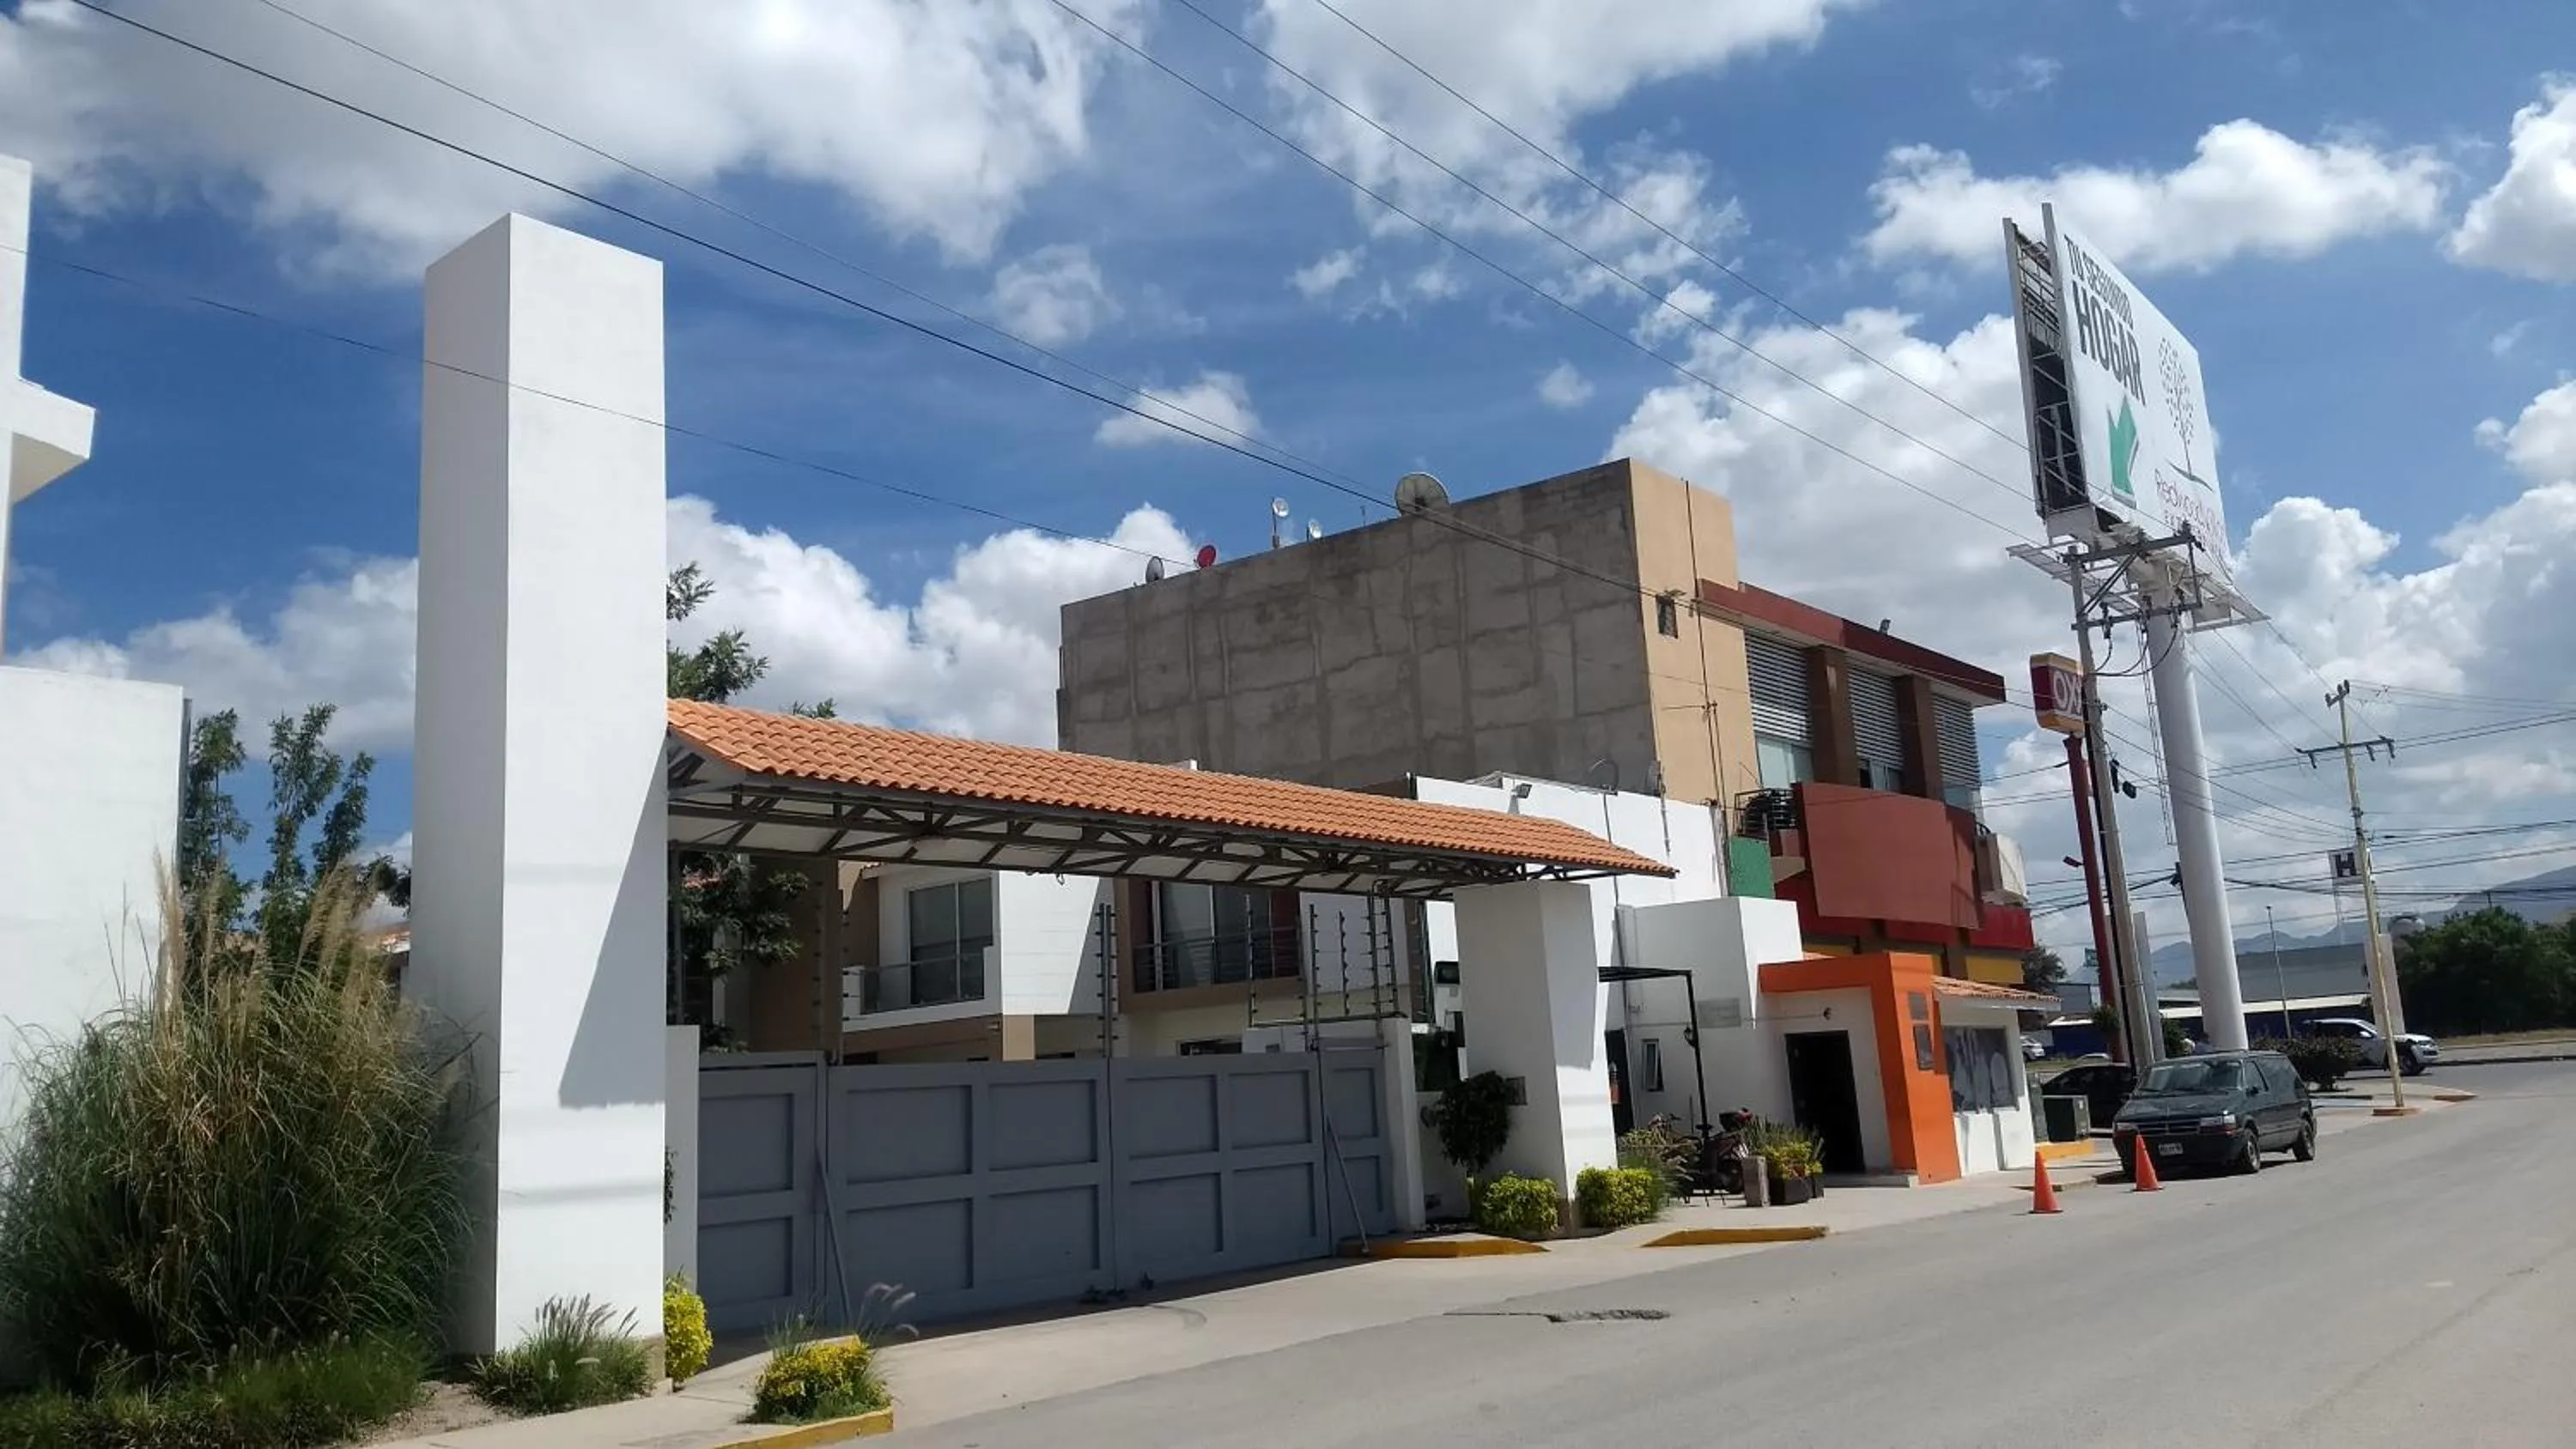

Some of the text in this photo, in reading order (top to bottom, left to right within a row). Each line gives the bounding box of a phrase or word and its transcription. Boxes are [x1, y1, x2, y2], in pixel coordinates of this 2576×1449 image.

[2064, 234, 2083, 282] TU
[2072, 280, 2145, 406] HOGAR
[2053, 670, 2081, 715] OX
